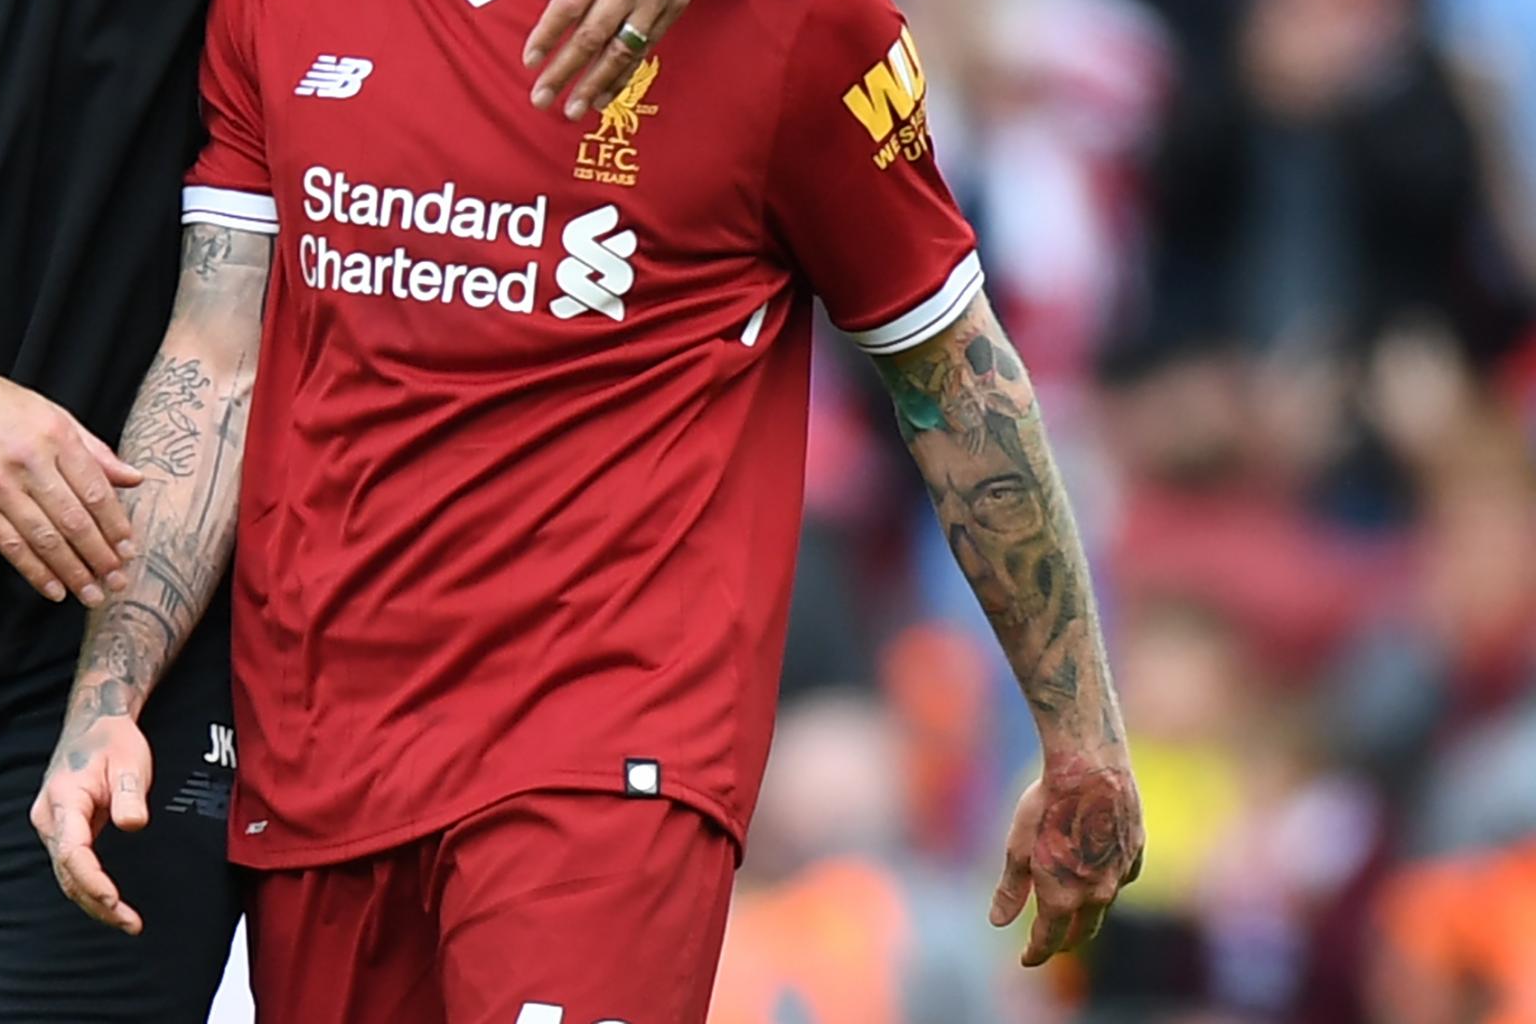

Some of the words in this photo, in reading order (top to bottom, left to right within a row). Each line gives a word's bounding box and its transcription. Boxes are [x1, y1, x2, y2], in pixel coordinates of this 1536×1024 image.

[303, 166, 547, 248] Standard
[299, 234, 538, 314] Chartered
[203, 723, 237, 769] JK
